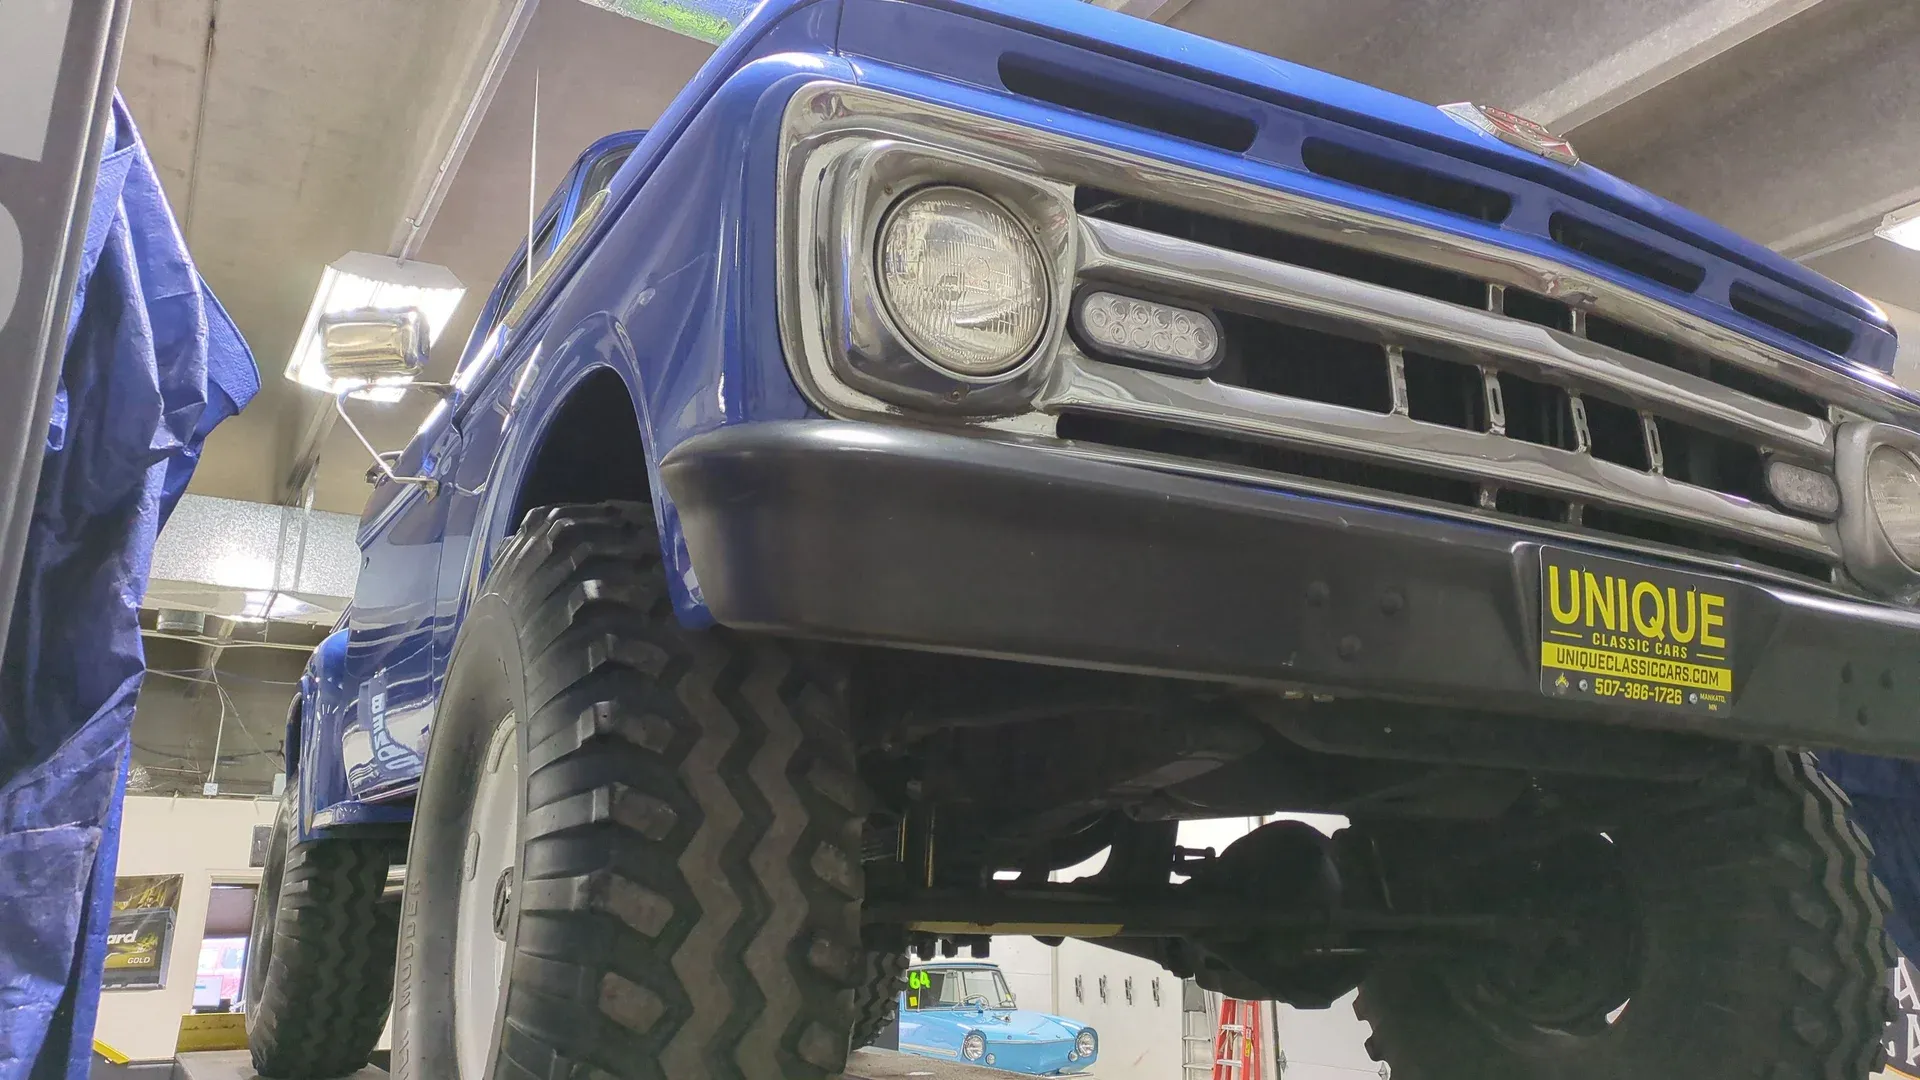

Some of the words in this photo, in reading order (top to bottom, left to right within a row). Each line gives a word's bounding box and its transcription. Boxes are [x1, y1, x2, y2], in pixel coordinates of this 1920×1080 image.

[1549, 565, 1725, 648] UNIQUE
[1592, 632, 1650, 653] CLASSIC
[1655, 642, 1688, 659] CARS
[1556, 647, 1719, 686] UNIQUECLASSICCARS.COM
[1595, 677, 1682, 705] 507-386-1726
[127, 956, 151, 964] GOLD
[909, 970, 931, 990] 64
